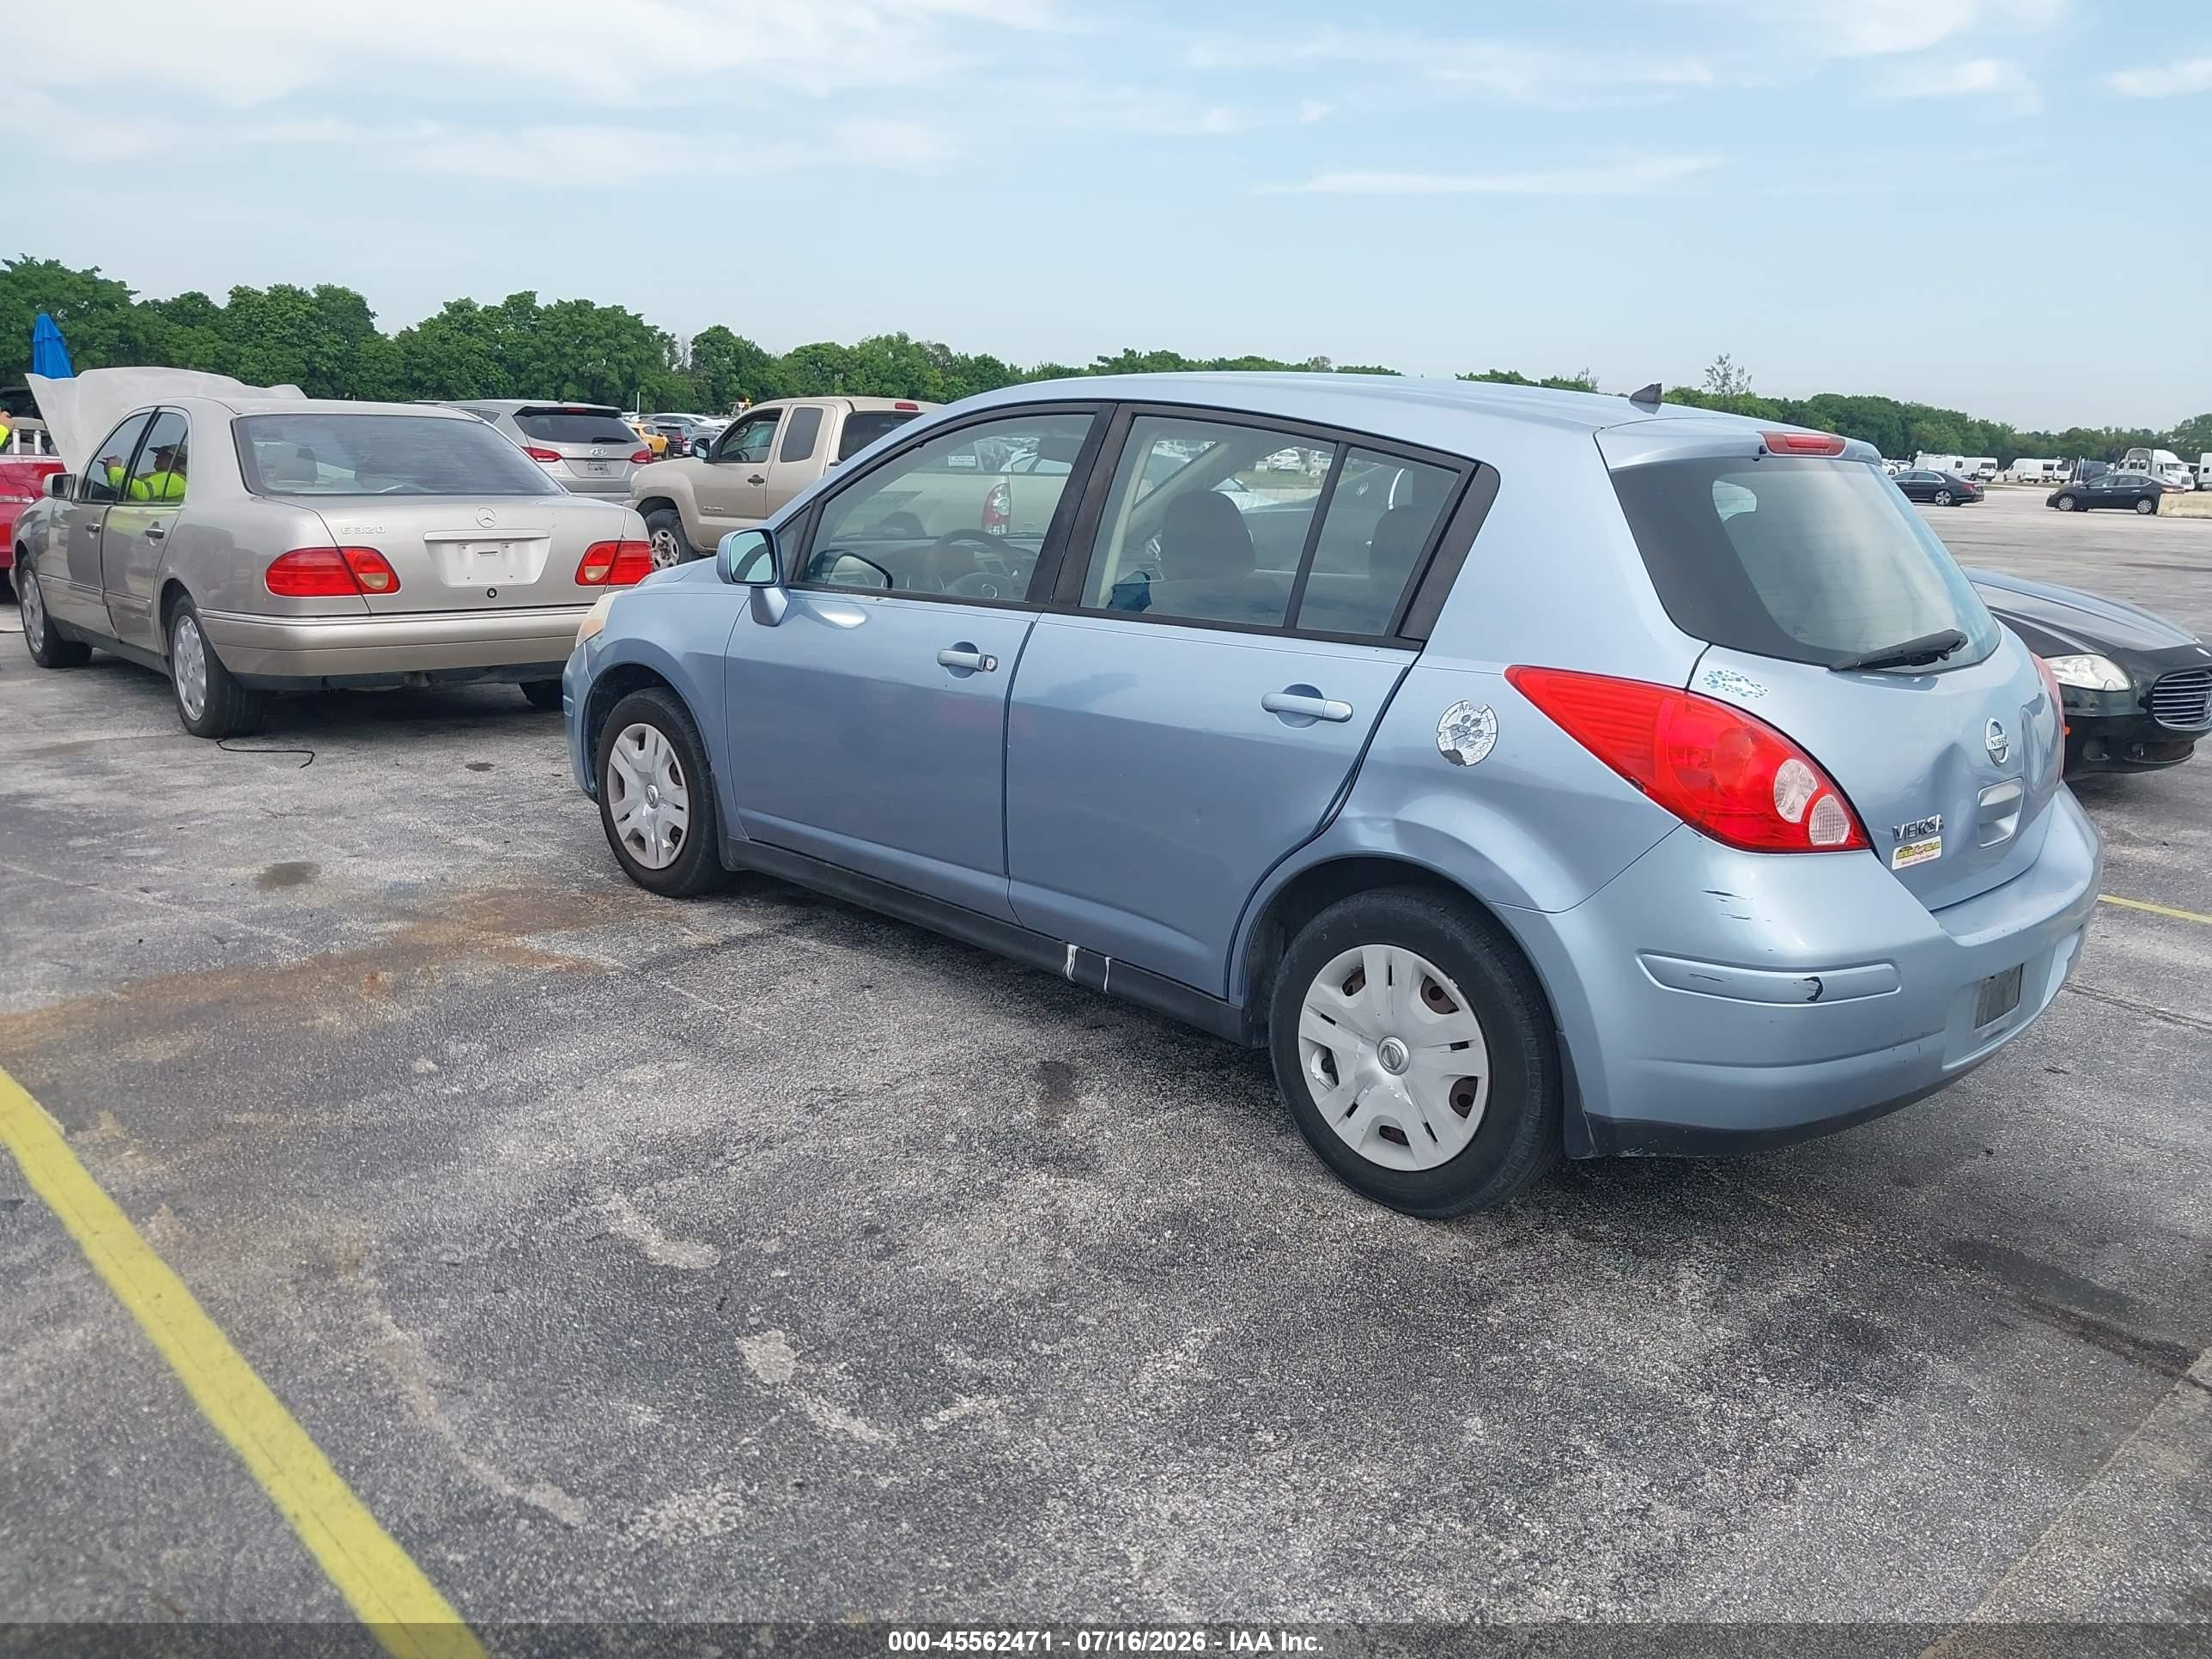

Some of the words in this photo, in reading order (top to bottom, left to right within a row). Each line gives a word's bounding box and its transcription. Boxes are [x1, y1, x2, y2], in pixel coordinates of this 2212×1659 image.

[341, 526, 351, 535] E
[354, 525, 386, 534] 320
[1892, 813, 1944, 842] VERSA
